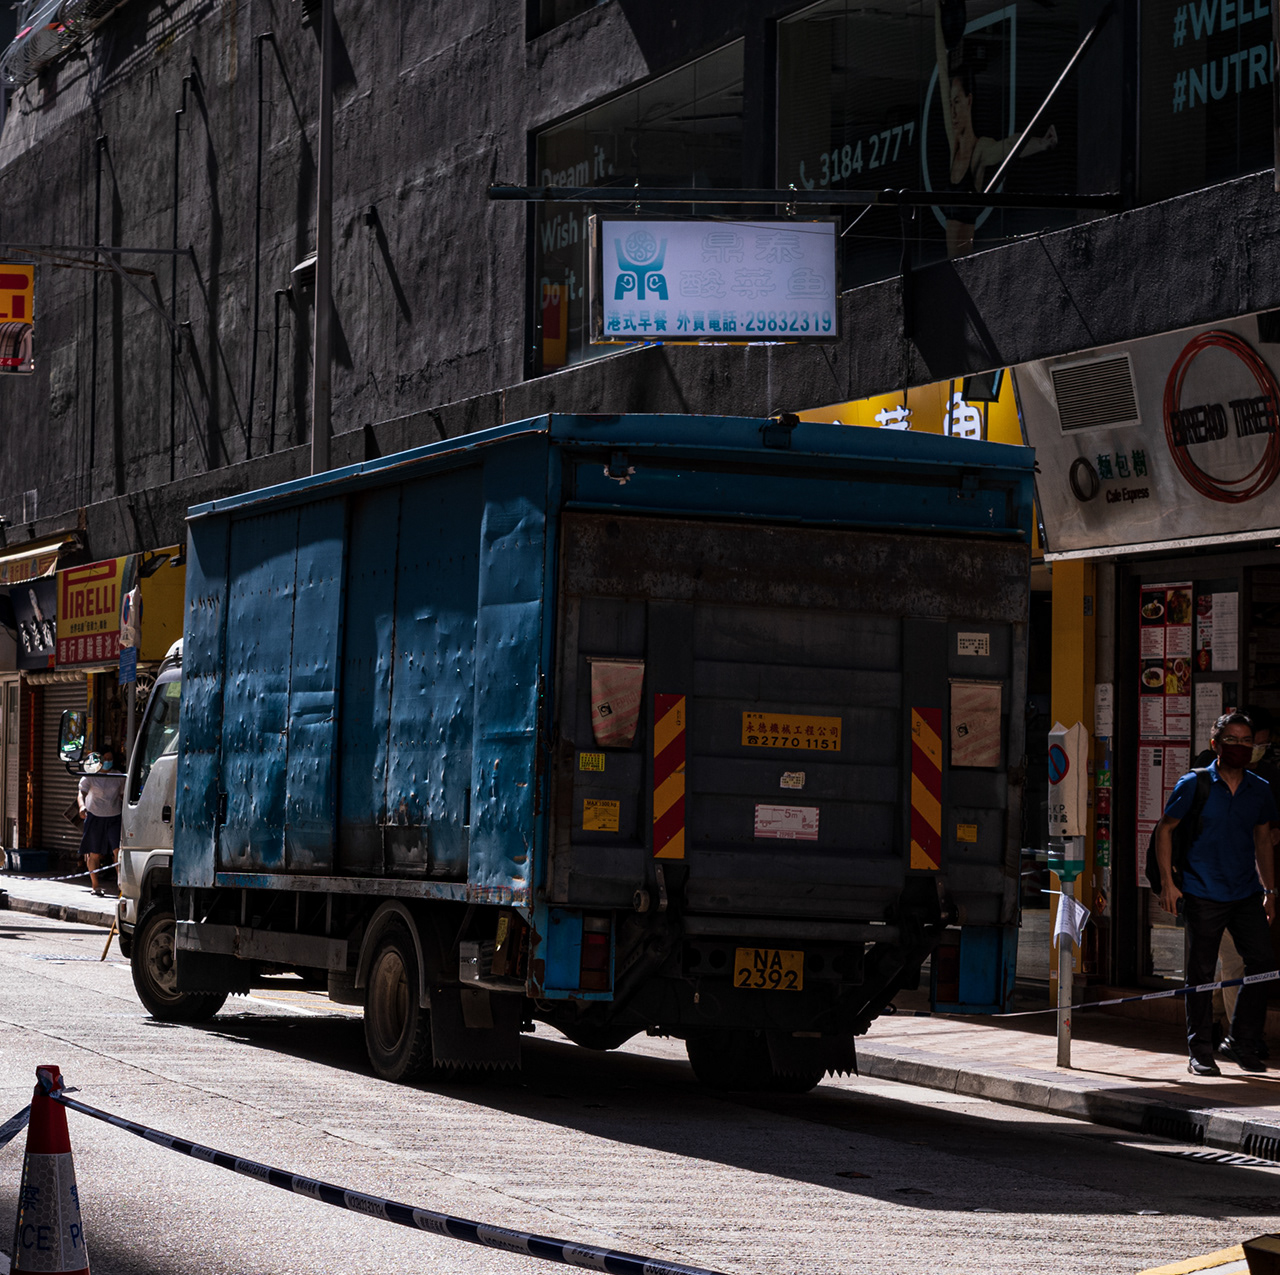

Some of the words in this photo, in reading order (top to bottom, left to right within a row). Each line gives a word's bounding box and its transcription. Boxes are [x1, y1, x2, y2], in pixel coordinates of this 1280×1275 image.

[820, 145, 863, 187] 3184
[867, 120, 916, 170] 2777
[540, 162, 589, 190] Dream
[540, 218, 579, 254] Wish
[606, 309, 668, 333] 港式早餐
[1170, 403, 1228, 447] BREAD
[1228, 394, 1277, 438] TREE
[62, 559, 117, 620] PIRELLI
[761, 736, 800, 747] 2770
[806, 739, 837, 749] 1151
[754, 949, 783, 970] NA
[738, 967, 798, 990] 2392
